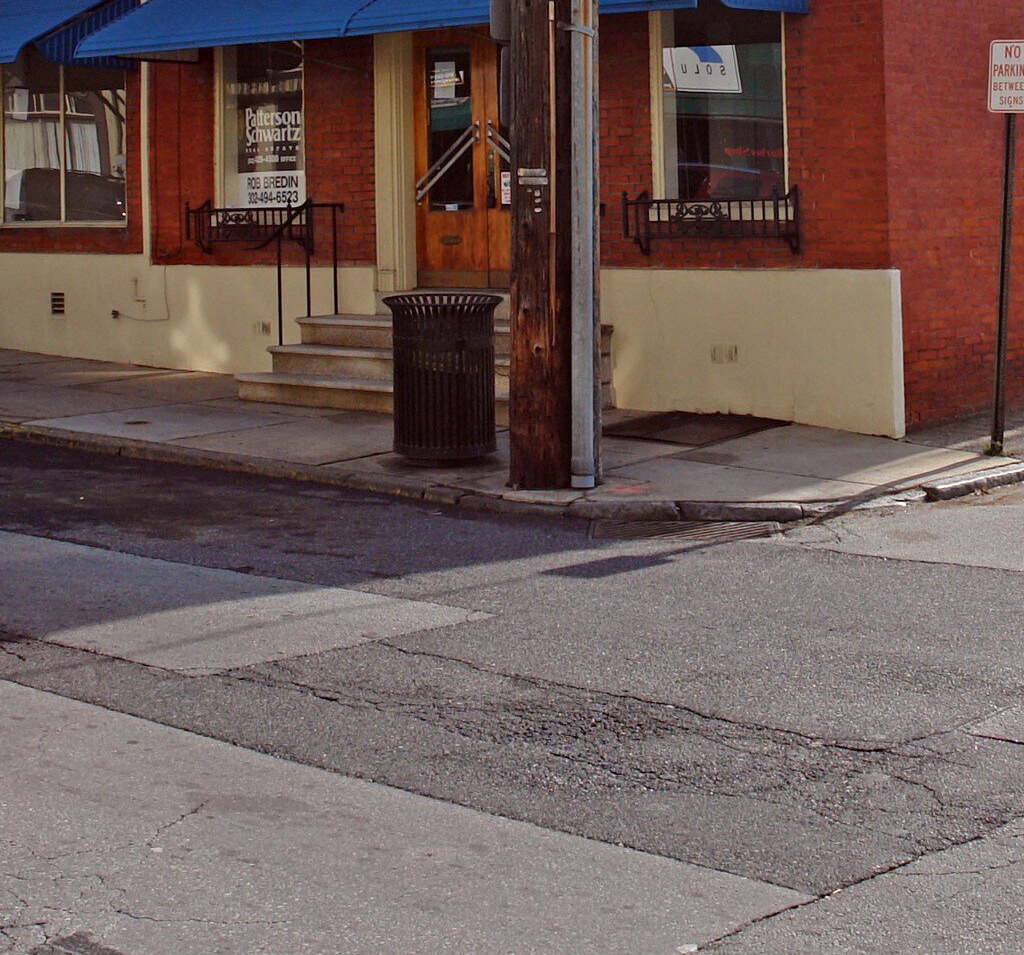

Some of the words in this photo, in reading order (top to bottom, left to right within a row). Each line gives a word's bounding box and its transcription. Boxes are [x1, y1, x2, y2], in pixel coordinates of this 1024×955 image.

[1004, 45, 1021, 59] NO
[999, 95, 1024, 106] SIGNS
[245, 107, 301, 127] Patterson
[245, 124, 301, 146] Schwartz
[247, 177, 260, 190] ROB
[263, 175, 299, 188] BREDIN
[248, 190, 299, 204] 302-494-6523
